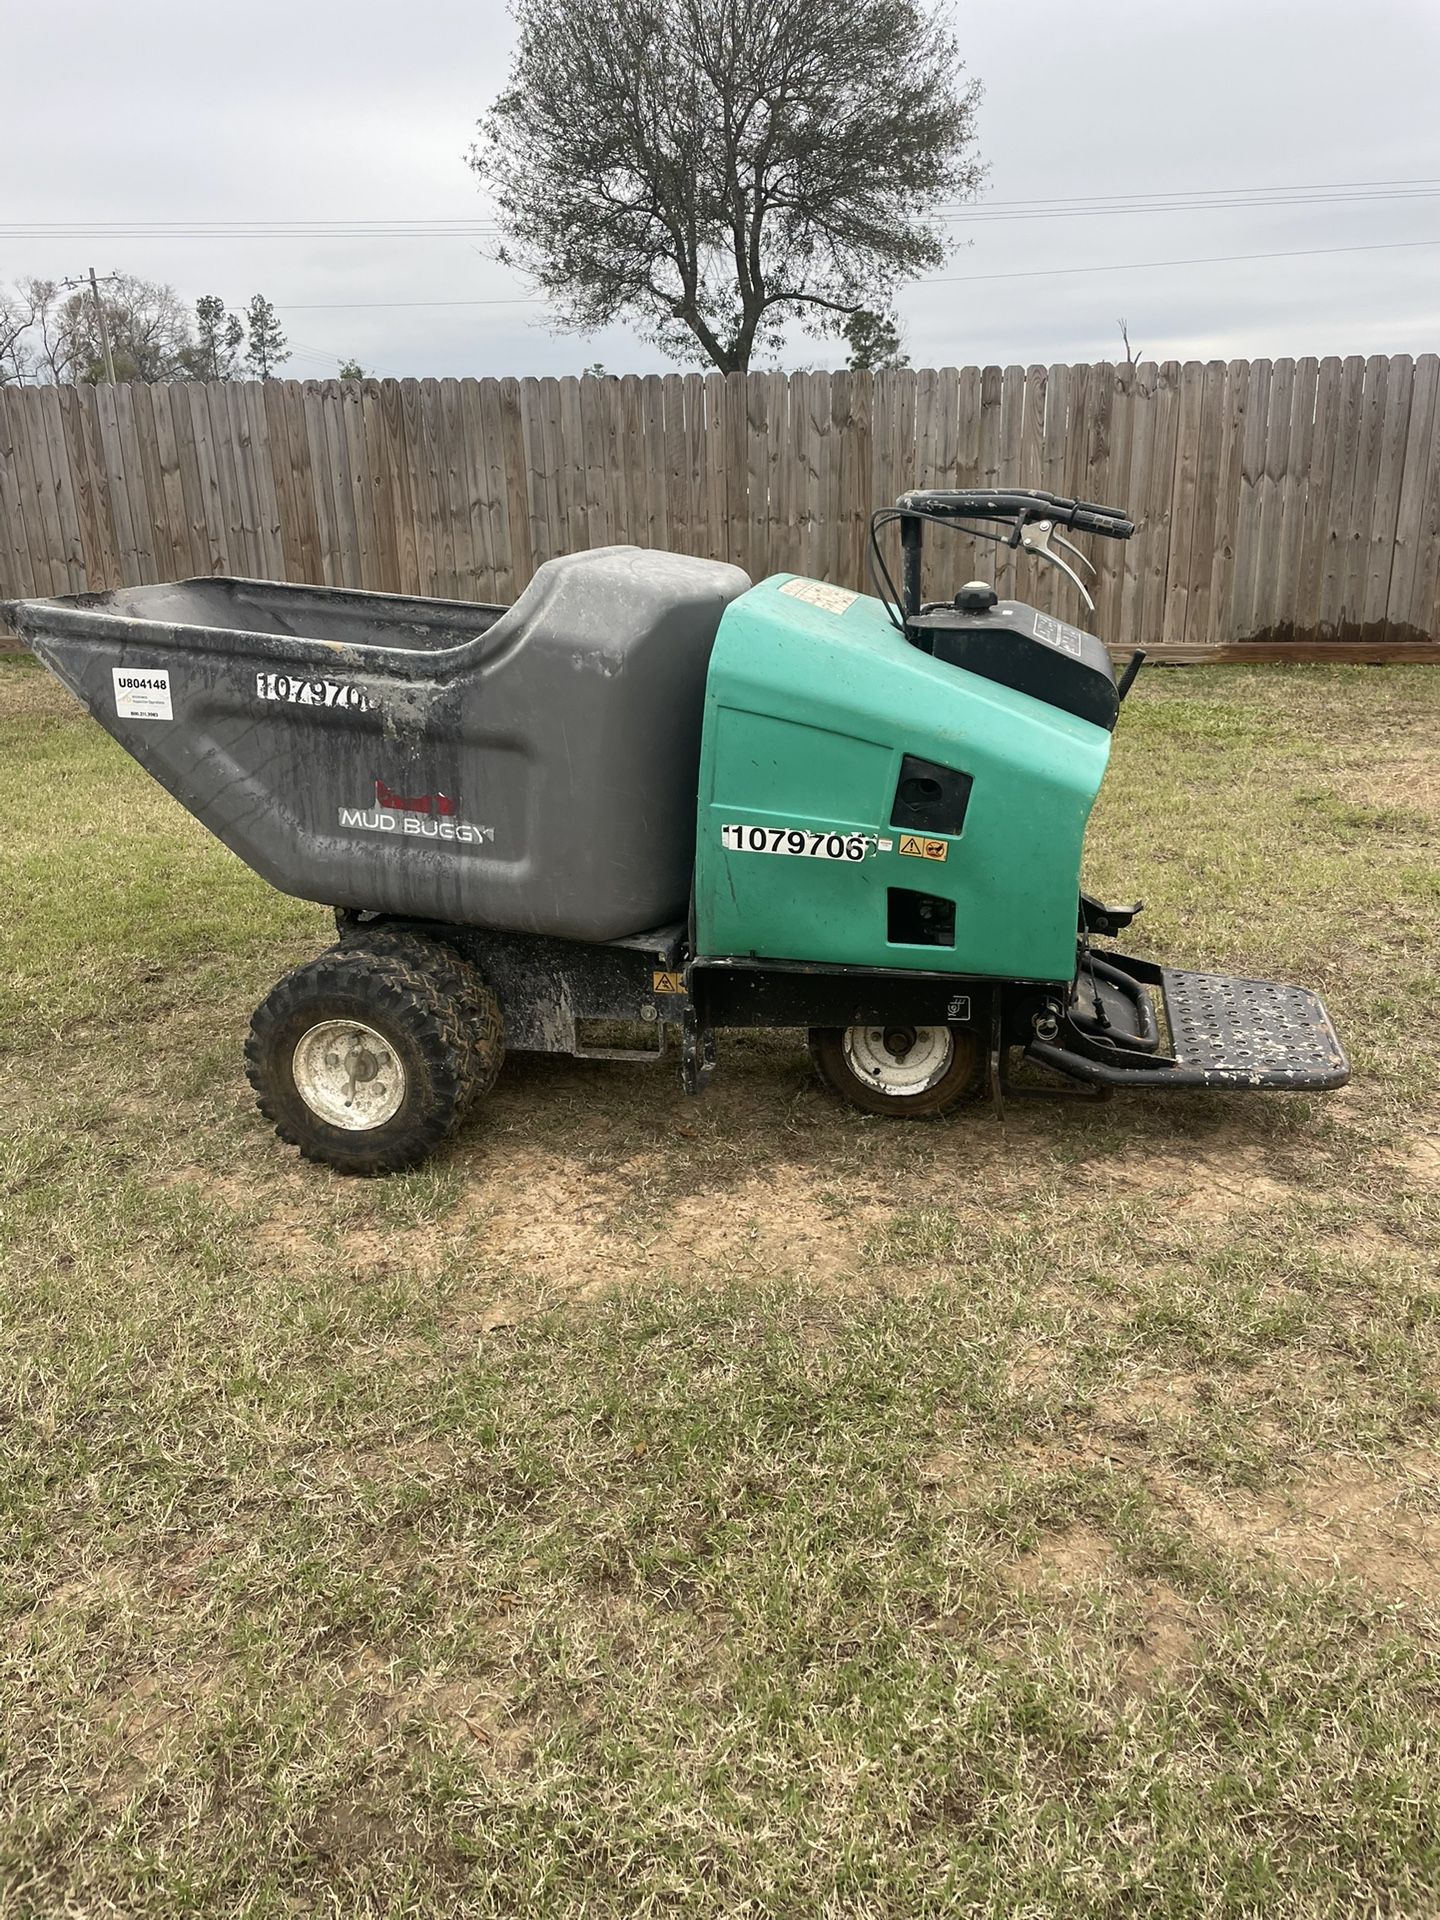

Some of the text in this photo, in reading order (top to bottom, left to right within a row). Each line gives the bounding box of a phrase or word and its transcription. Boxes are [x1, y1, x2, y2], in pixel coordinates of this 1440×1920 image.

[118, 677, 167, 690] U804148
[341, 809, 491, 844] MUD BUGGY
[731, 825, 864, 861] 1079706
